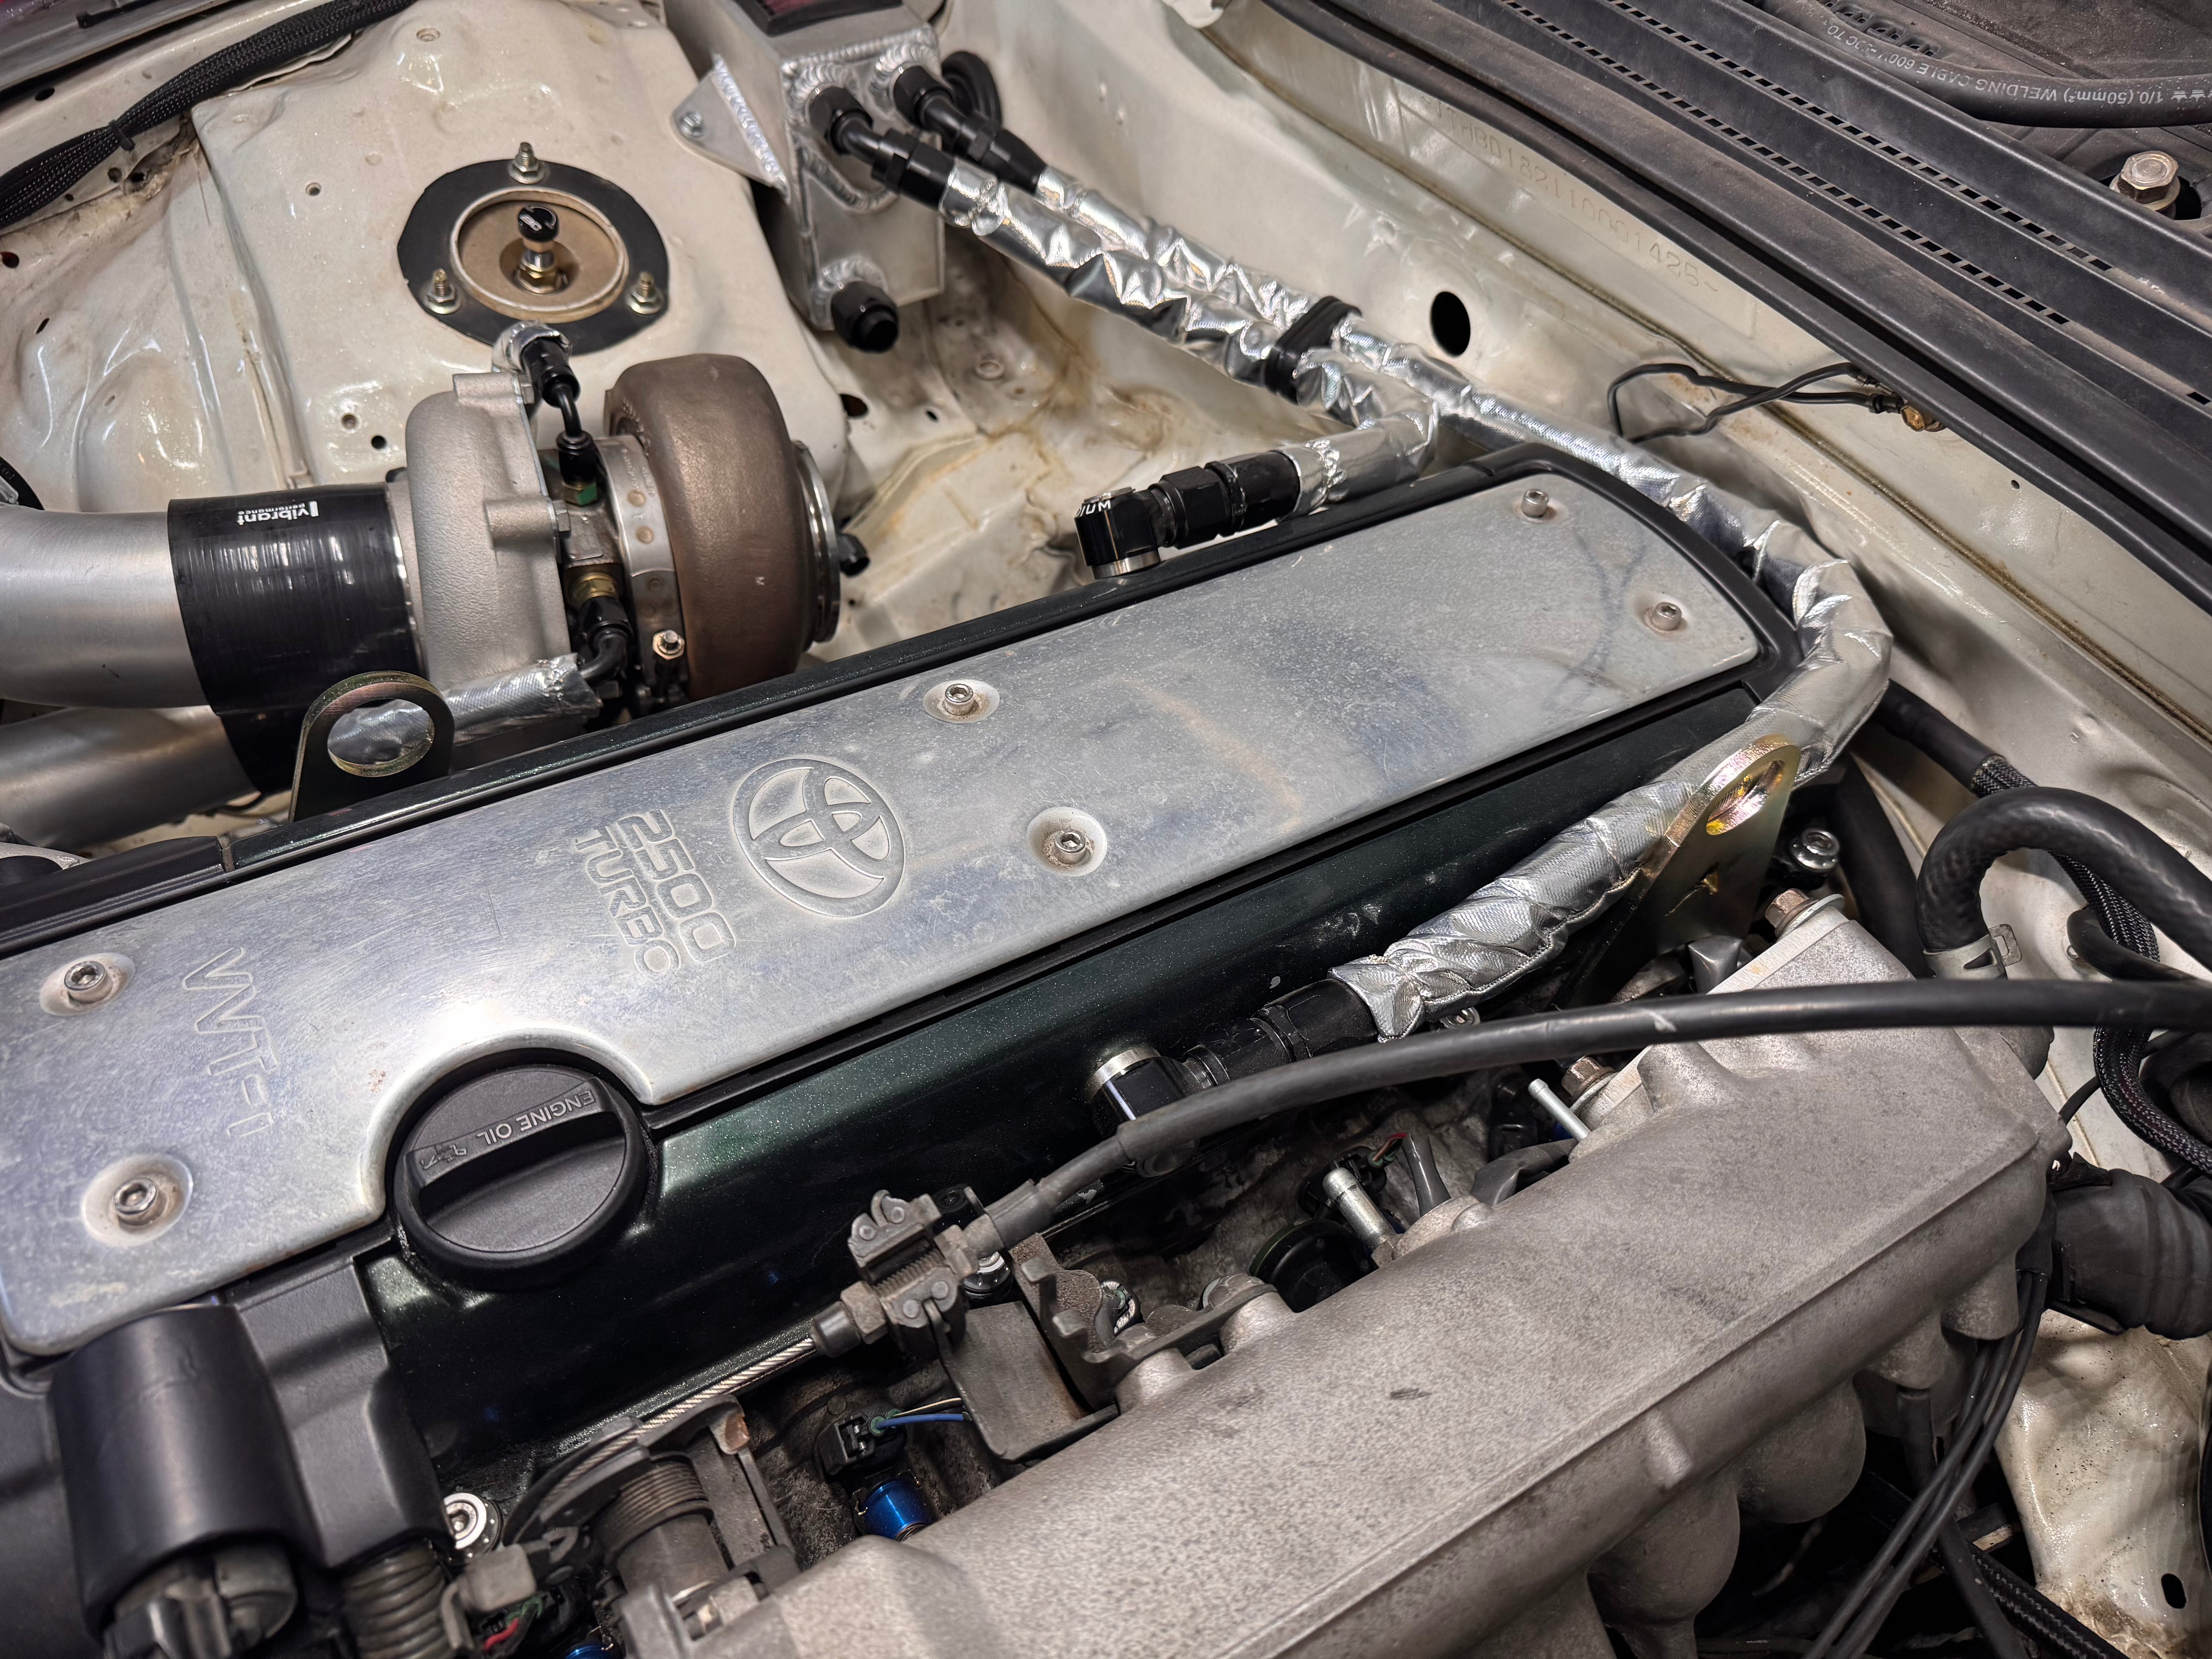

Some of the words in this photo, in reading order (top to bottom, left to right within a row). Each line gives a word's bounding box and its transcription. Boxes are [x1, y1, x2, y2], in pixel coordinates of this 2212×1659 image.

[1827, 25, 1846, 40] TO
[1916, 63, 1970, 87] CABLE
[1975, 79, 2057, 101] WELDING
[237, 507, 310, 526] vibrant
[238, 502, 306, 515] performance
[617, 808, 737, 963] 2500
[575, 826, 682, 974] TURBO
[515, 1089, 596, 1132] ENGINE
[476, 1123, 512, 1145] OIL
